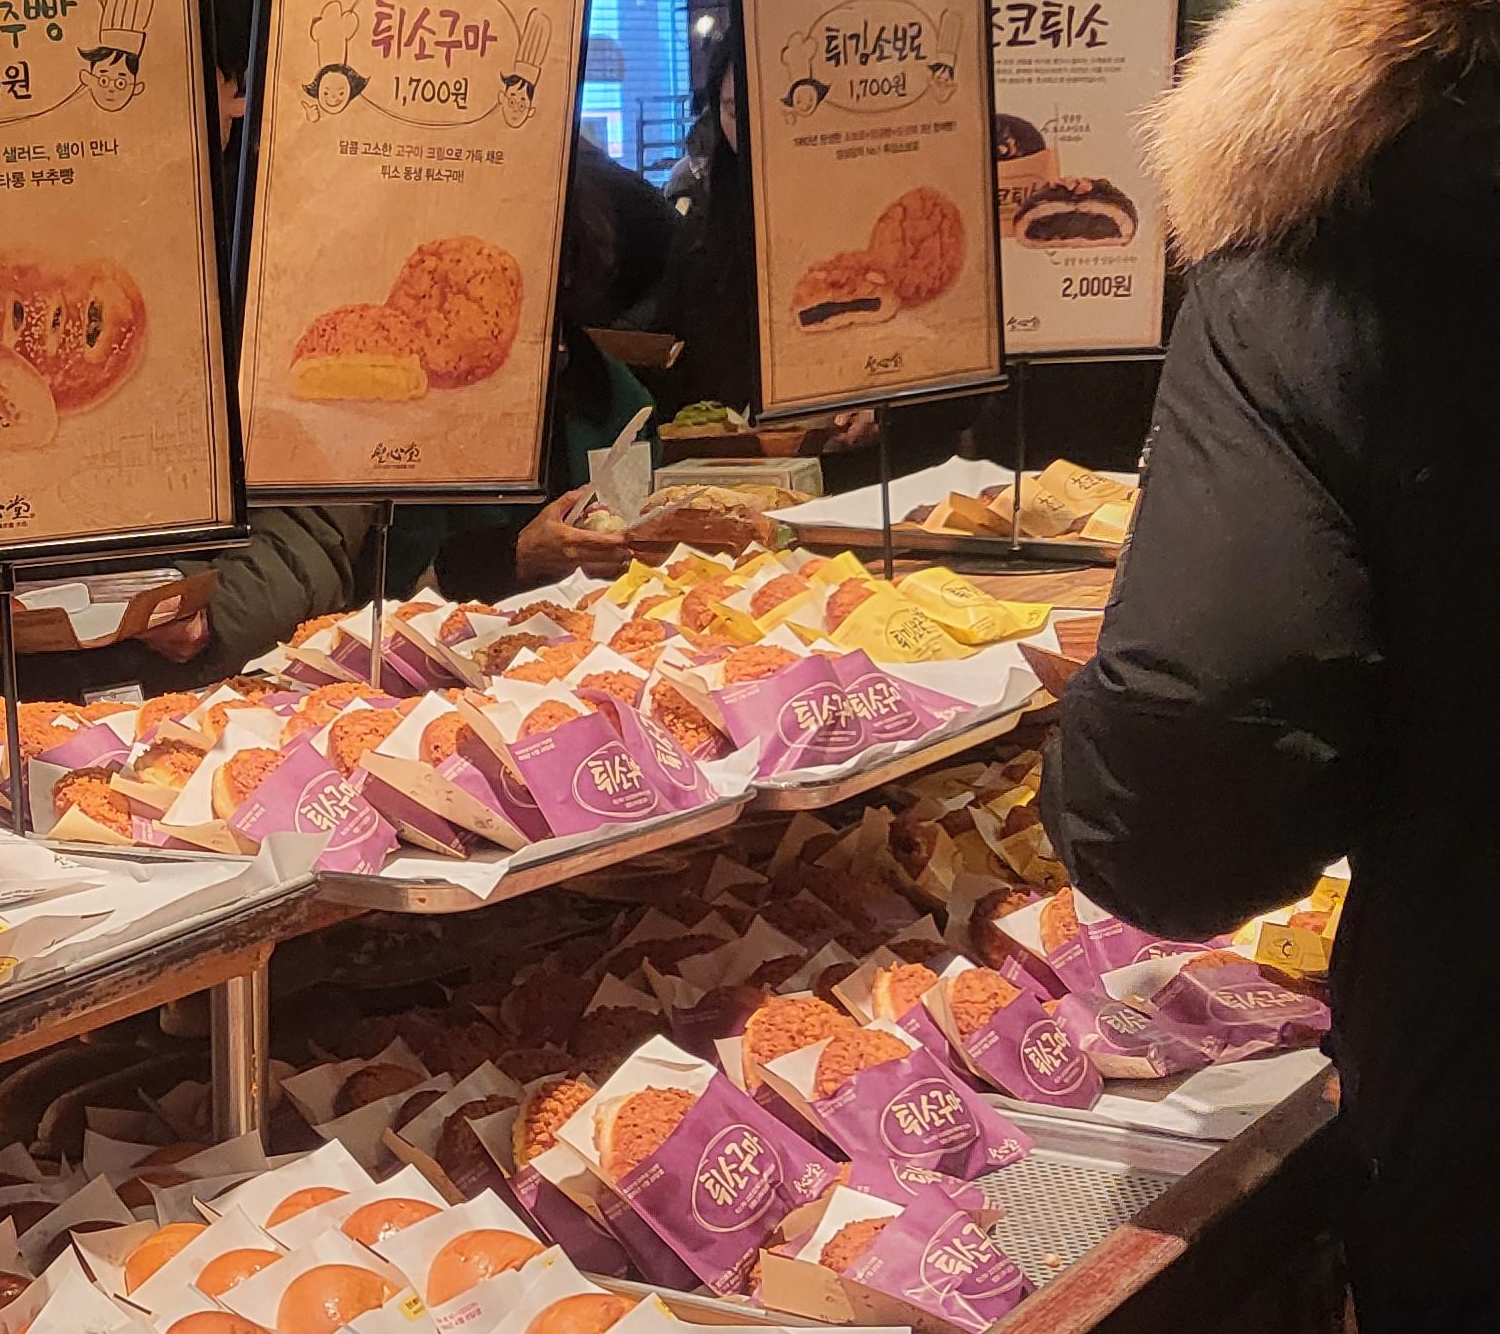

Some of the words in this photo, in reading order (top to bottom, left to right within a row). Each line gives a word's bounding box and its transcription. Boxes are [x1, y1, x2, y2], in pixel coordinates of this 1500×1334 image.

[825, 20, 928, 67] 튀김소보로
[393, 77, 469, 109] 1,700원
[849, 72, 907, 103] 1,700원
[55, 141, 85, 159] 햄이
[89, 139, 119, 156] 만나
[339, 140, 359, 155] 달콤
[361, 142, 392, 157] 고소한
[31, 168, 74, 186] 부추빵
[1061, 274, 1133, 299] 2,000원
[1024, 1026, 1072, 1077] 튀소구마
[890, 1089, 965, 1137] 튀소구마
[699, 1131, 765, 1206] 튀소구마
[926, 1222, 1002, 1275] 튀소구
